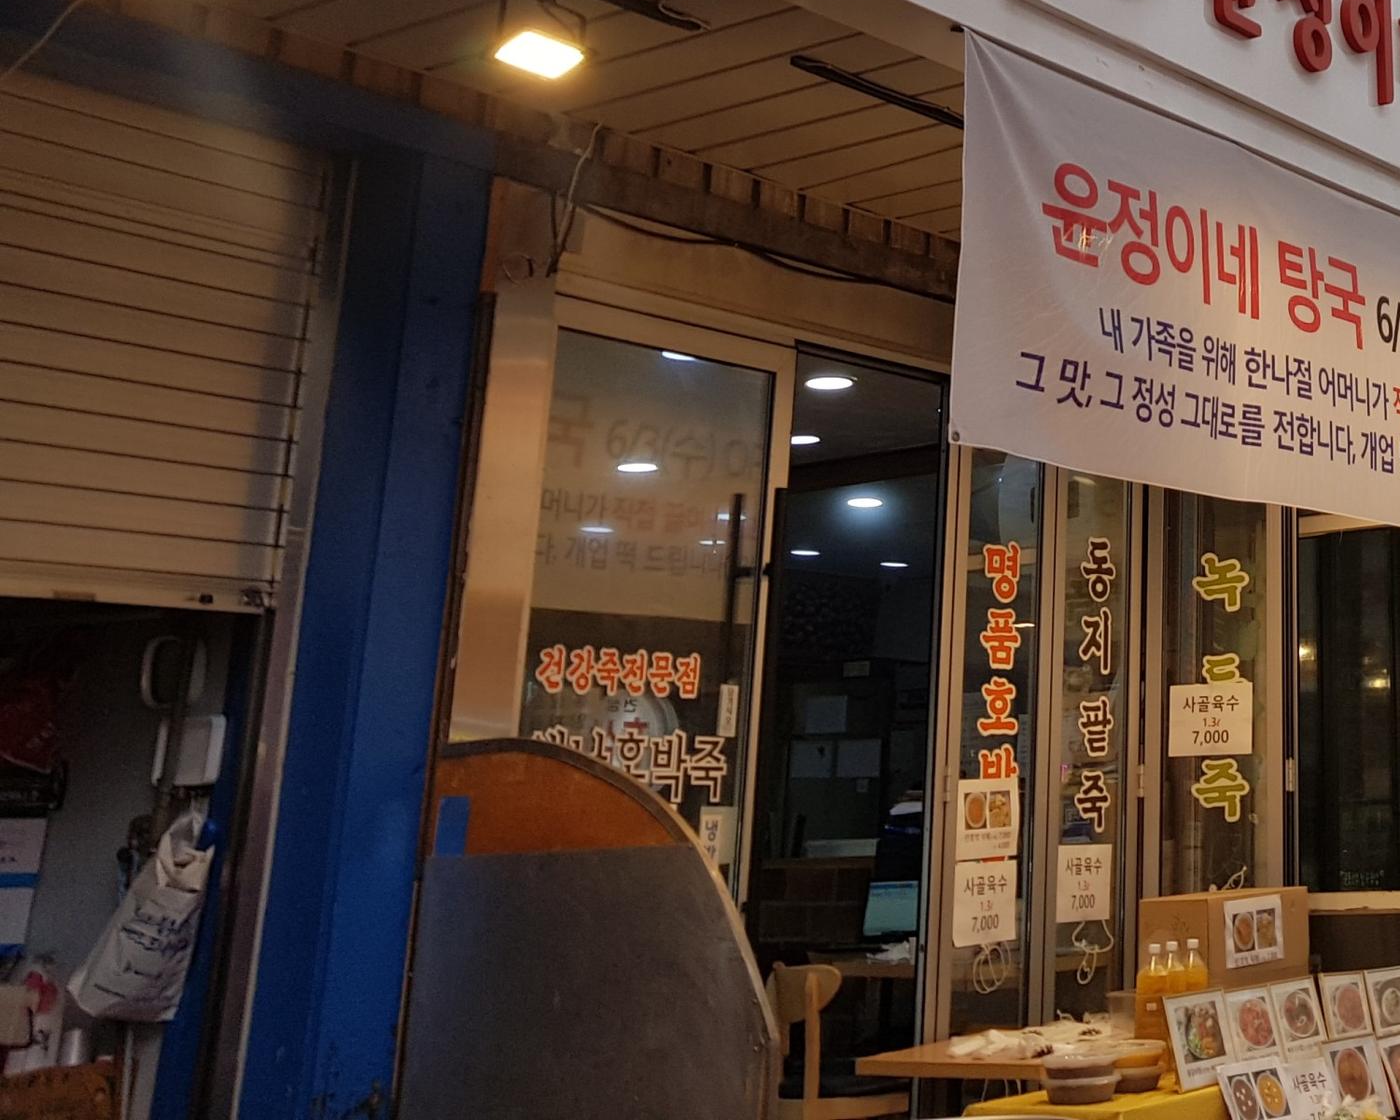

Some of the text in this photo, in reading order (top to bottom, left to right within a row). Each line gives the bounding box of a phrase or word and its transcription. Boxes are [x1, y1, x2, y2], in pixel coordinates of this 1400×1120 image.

[1042, 162, 1260, 320] 윤정이네
[1278, 240, 1366, 350] 탕국
[1099, 307, 1124, 353] 내
[1130, 316, 1197, 372] 가족을
[1202, 335, 1237, 385] 위해
[1244, 346, 1313, 401] 한나절
[1318, 367, 1390, 421] 어머니가
[1016, 351, 1046, 393] 그
[1056, 358, 1092, 408] 맛,
[1100, 371, 1125, 410] 그
[1132, 376, 1177, 428] 정성
[1180, 391, 1266, 447] 그대로를
[1272, 409, 1356, 466] 전합니다,
[1360, 431, 1395, 475] 개업
[536, 644, 701, 699] 건강죽전문점
[978, 540, 1021, 864] 명품호박
[1182, 695, 1240, 713] 사골육수
[1191, 729, 1230, 746] 7,000
[1065, 857, 1102, 876] 사골육수
[964, 874, 1008, 897] 사골육수
[1071, 894, 1095, 911] 7,000
[971, 914, 999, 934] 7,000
